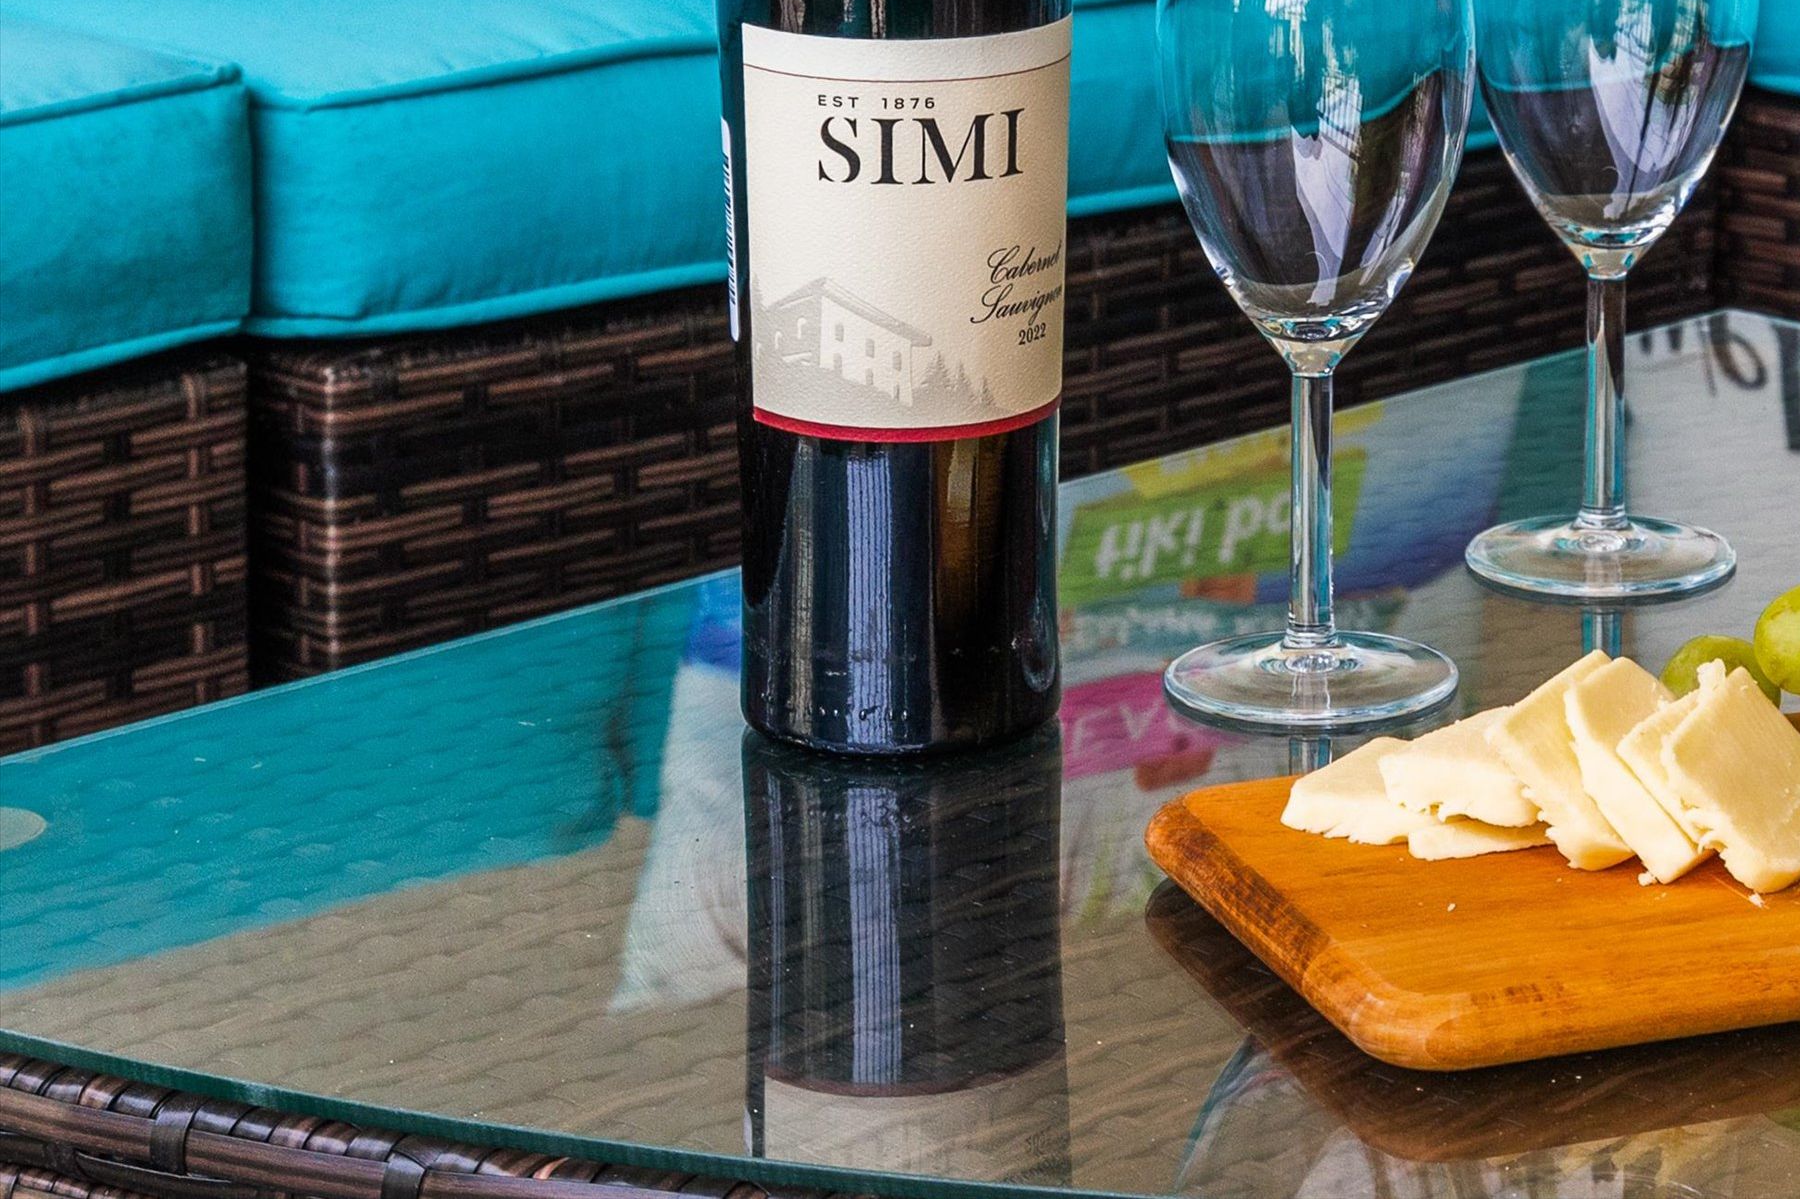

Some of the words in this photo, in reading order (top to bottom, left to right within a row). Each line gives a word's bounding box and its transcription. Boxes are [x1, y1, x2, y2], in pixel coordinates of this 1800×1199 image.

[818, 94, 859, 108] EST
[882, 97, 935, 110] 1876
[818, 108, 1025, 185] SIMI
[987, 240, 1062, 284] Cabernet
[1018, 323, 1047, 345] 2022
